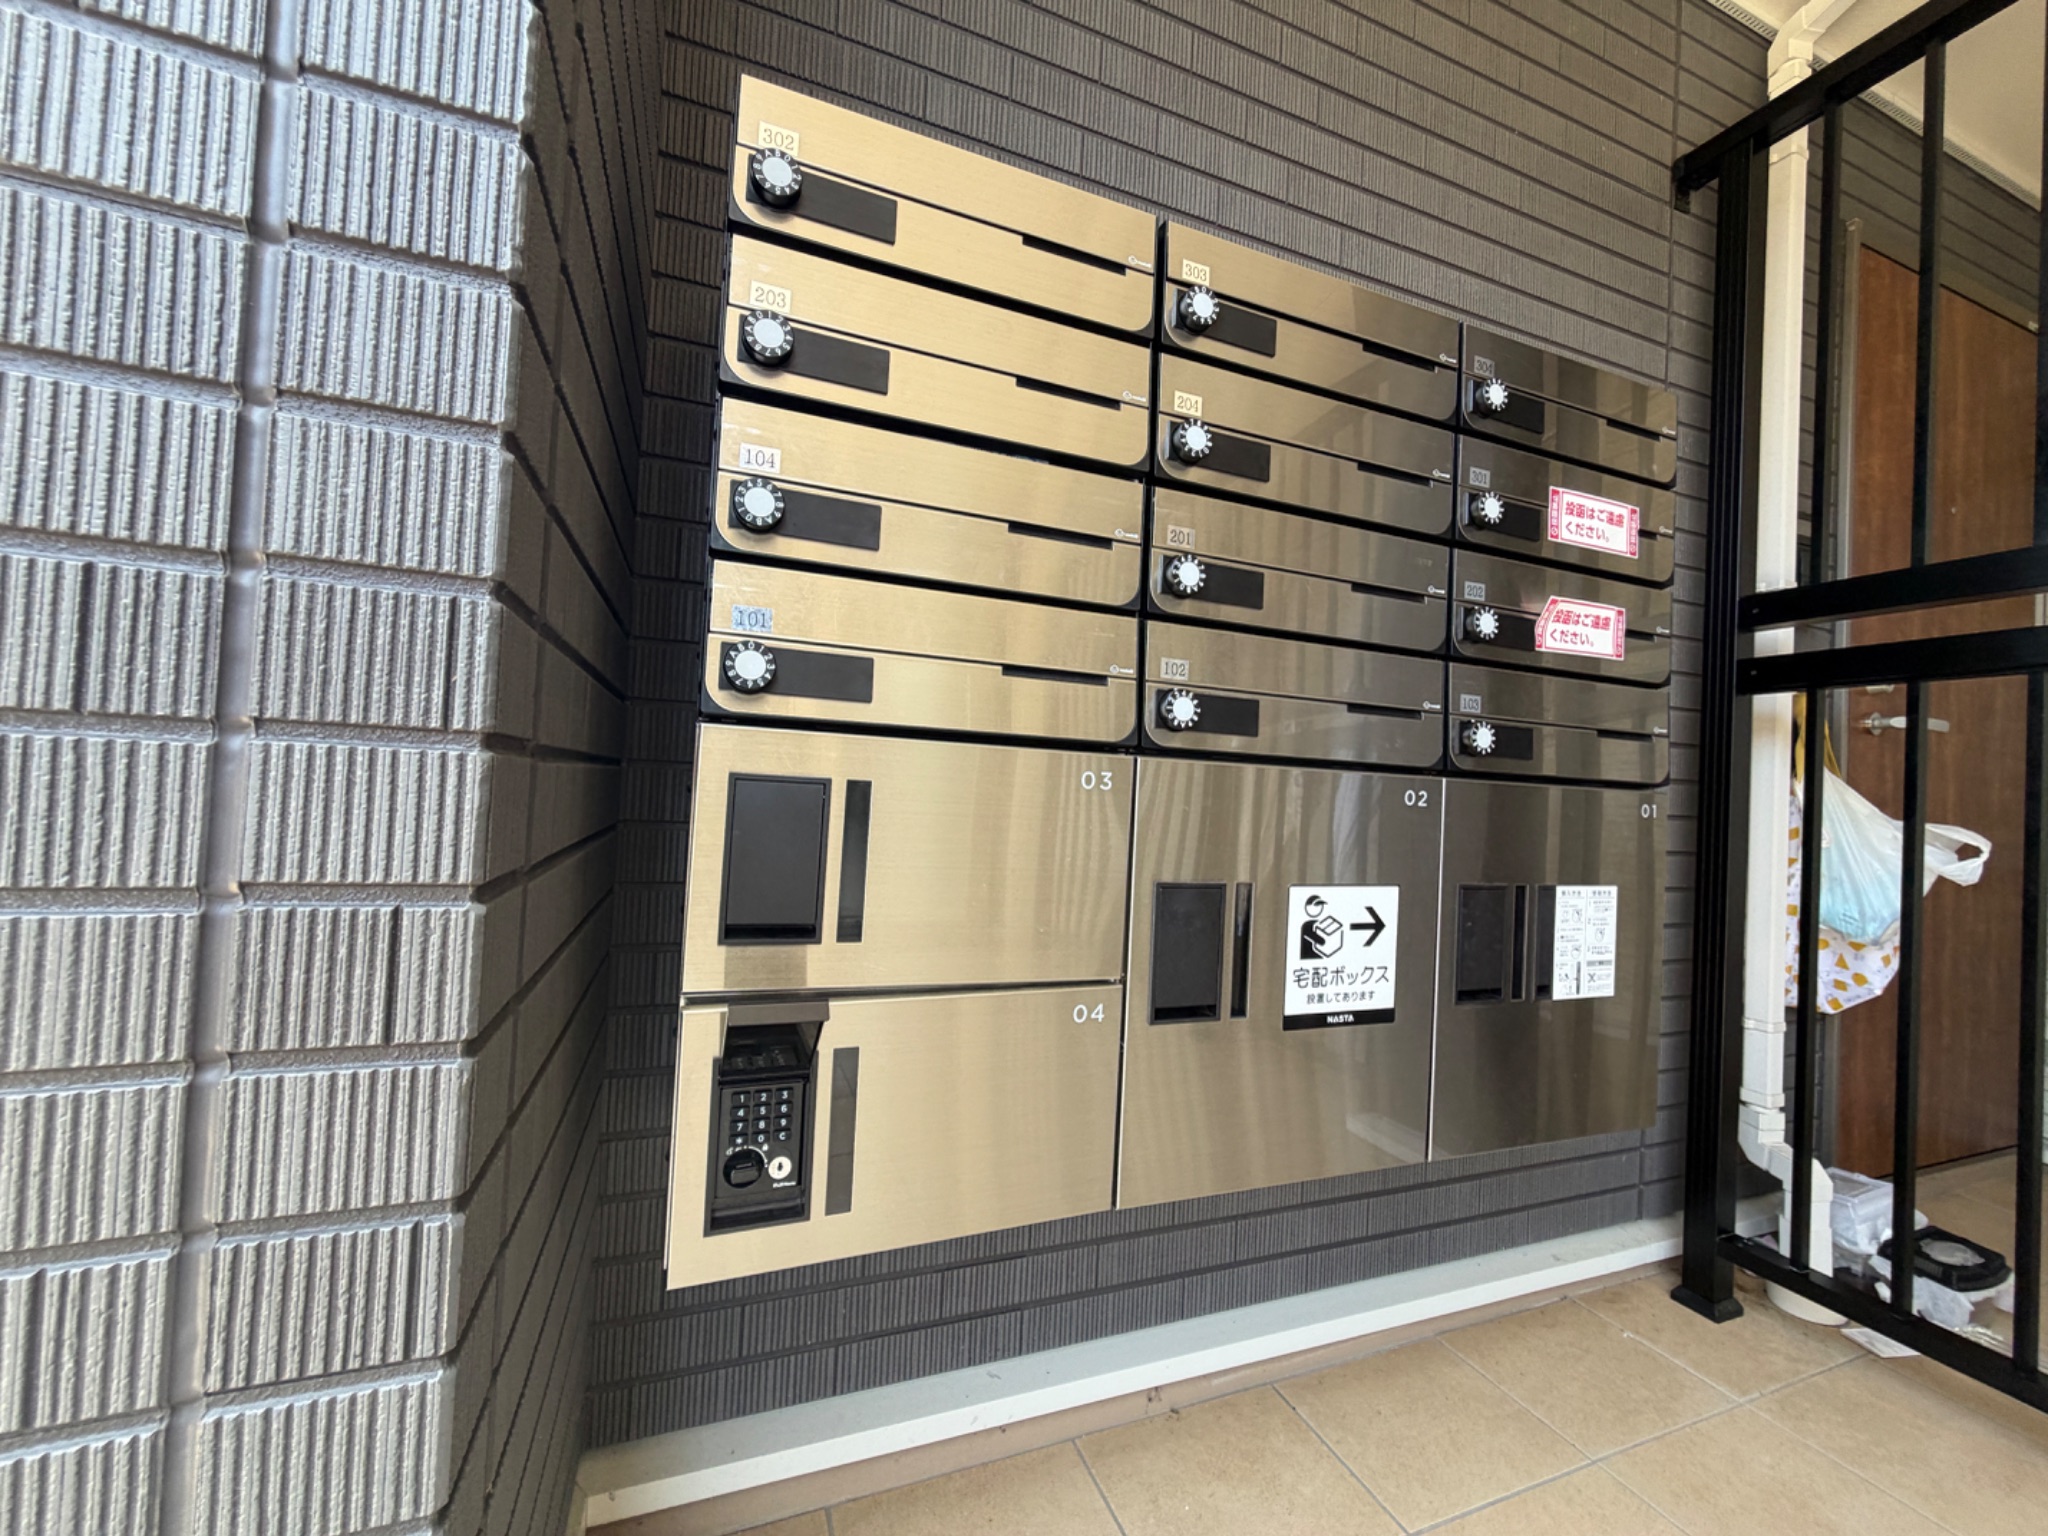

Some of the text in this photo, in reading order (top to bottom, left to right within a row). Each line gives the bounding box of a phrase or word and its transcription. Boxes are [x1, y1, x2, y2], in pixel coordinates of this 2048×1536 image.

[763, 128, 794, 151] 302
[1185, 264, 1207, 281] 303
[755, 287, 786, 308] 203
[1177, 395, 1198, 412] 204
[744, 449, 775, 468] 104
[1170, 529, 1191, 545] 201
[1565, 521, 1610, 543] ください。
[1467, 584, 1483, 598] 202
[737, 610, 767, 628] 101
[1550, 628, 1594, 647] ください。
[1164, 661, 1186, 677] 102
[1081, 770, 1113, 790] 03
[1404, 789, 1428, 807] 02
[1641, 804, 1657, 819] 01
[1293, 965, 1389, 989] 宅配ボックス
[1306, 990, 1375, 1005] 設置してあります
[1073, 1004, 1105, 1023] 04
[1326, 1014, 1355, 1024] NASTA
[760, 1093, 767, 1101] 2
[782, 1090, 788, 1099] 3
[737, 1105, 787, 1117] 4 5 6
[737, 1118, 786, 1131] 7 8 9
[758, 1132, 786, 1143] 0 C
